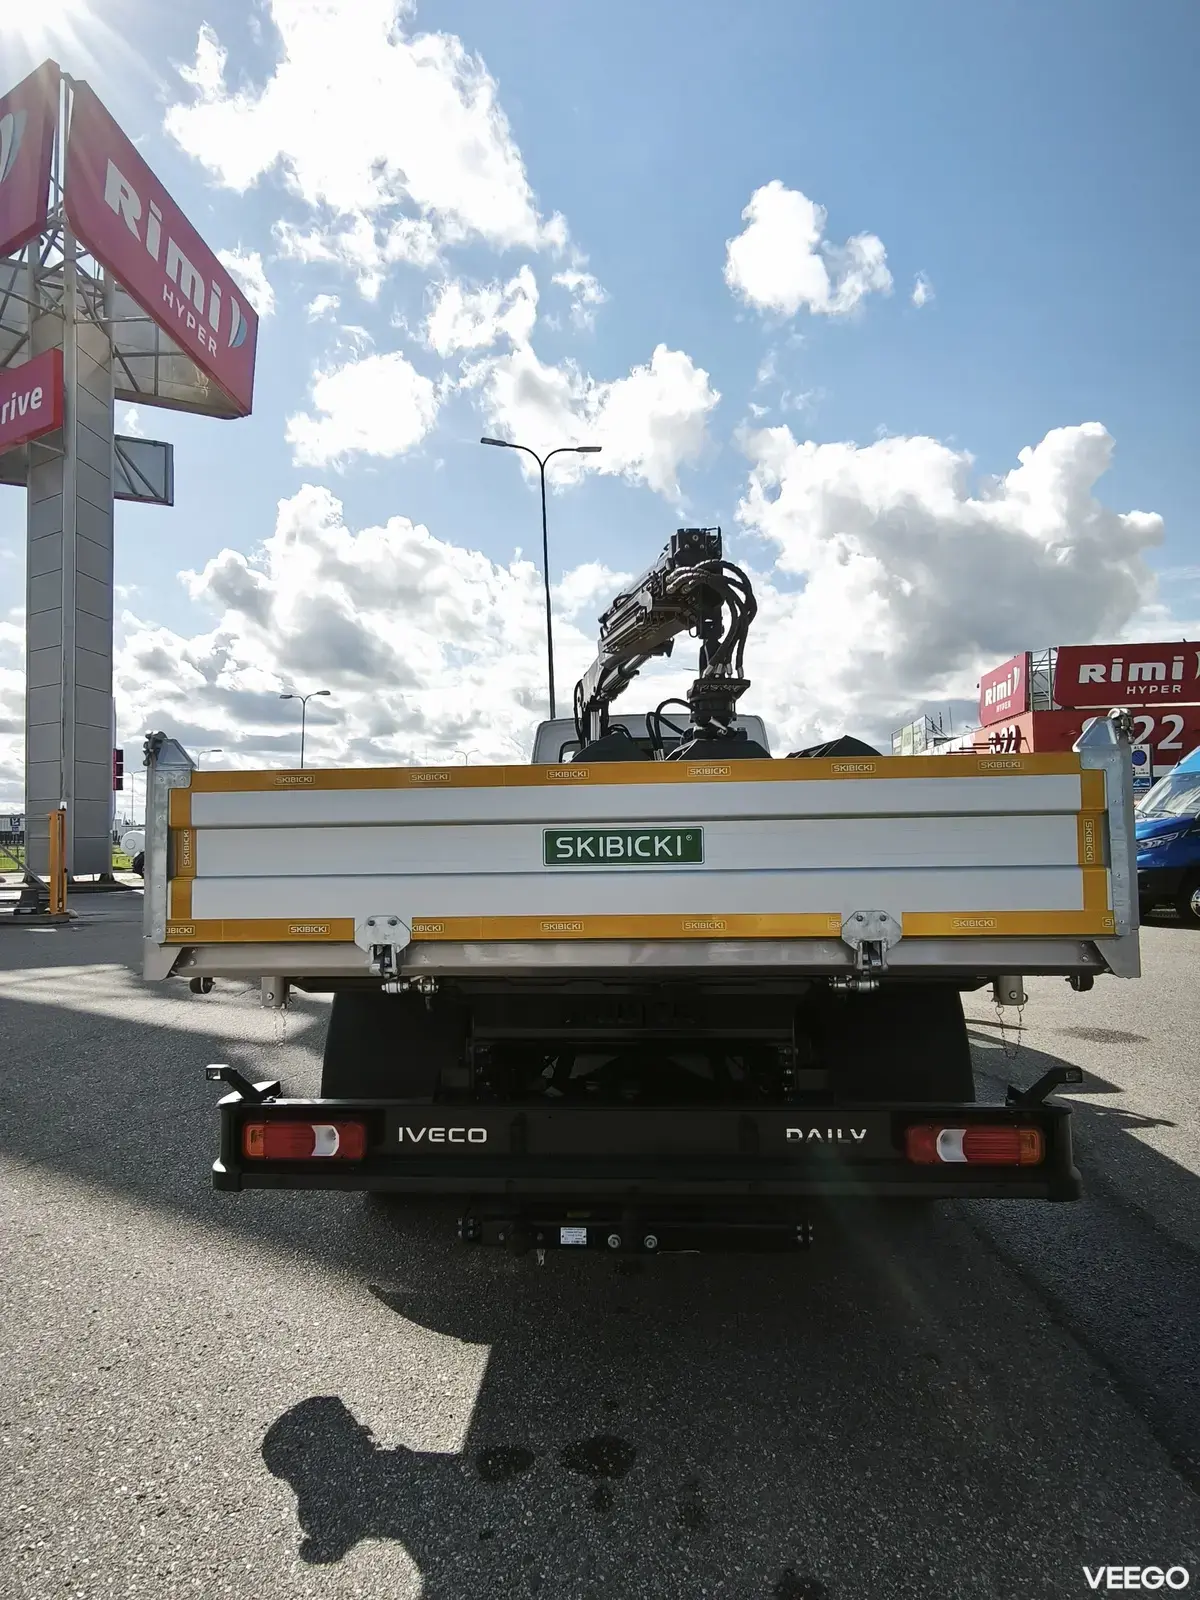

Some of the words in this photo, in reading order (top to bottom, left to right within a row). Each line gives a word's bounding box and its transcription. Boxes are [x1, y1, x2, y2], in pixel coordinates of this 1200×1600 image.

[163, 285, 217, 358] HYPER
[1, 386, 43, 425] rive
[1126, 684, 1182, 695] HYPER
[833, 764, 873, 772] SKIBICKI
[979, 761, 1021, 769] SKIBICKI
[549, 770, 587, 778] SKIBICKI
[689, 767, 728, 775] SKIBICKI
[411, 773, 448, 781] SKIBICKI
[1085, 821, 1094, 861] SKIBICKI
[953, 919, 994, 927] SKIBICKI
[412, 924, 442, 932] KIBICKI
[398, 1127, 487, 1143] IVECO
[786, 1128, 867, 1144] DAILY
